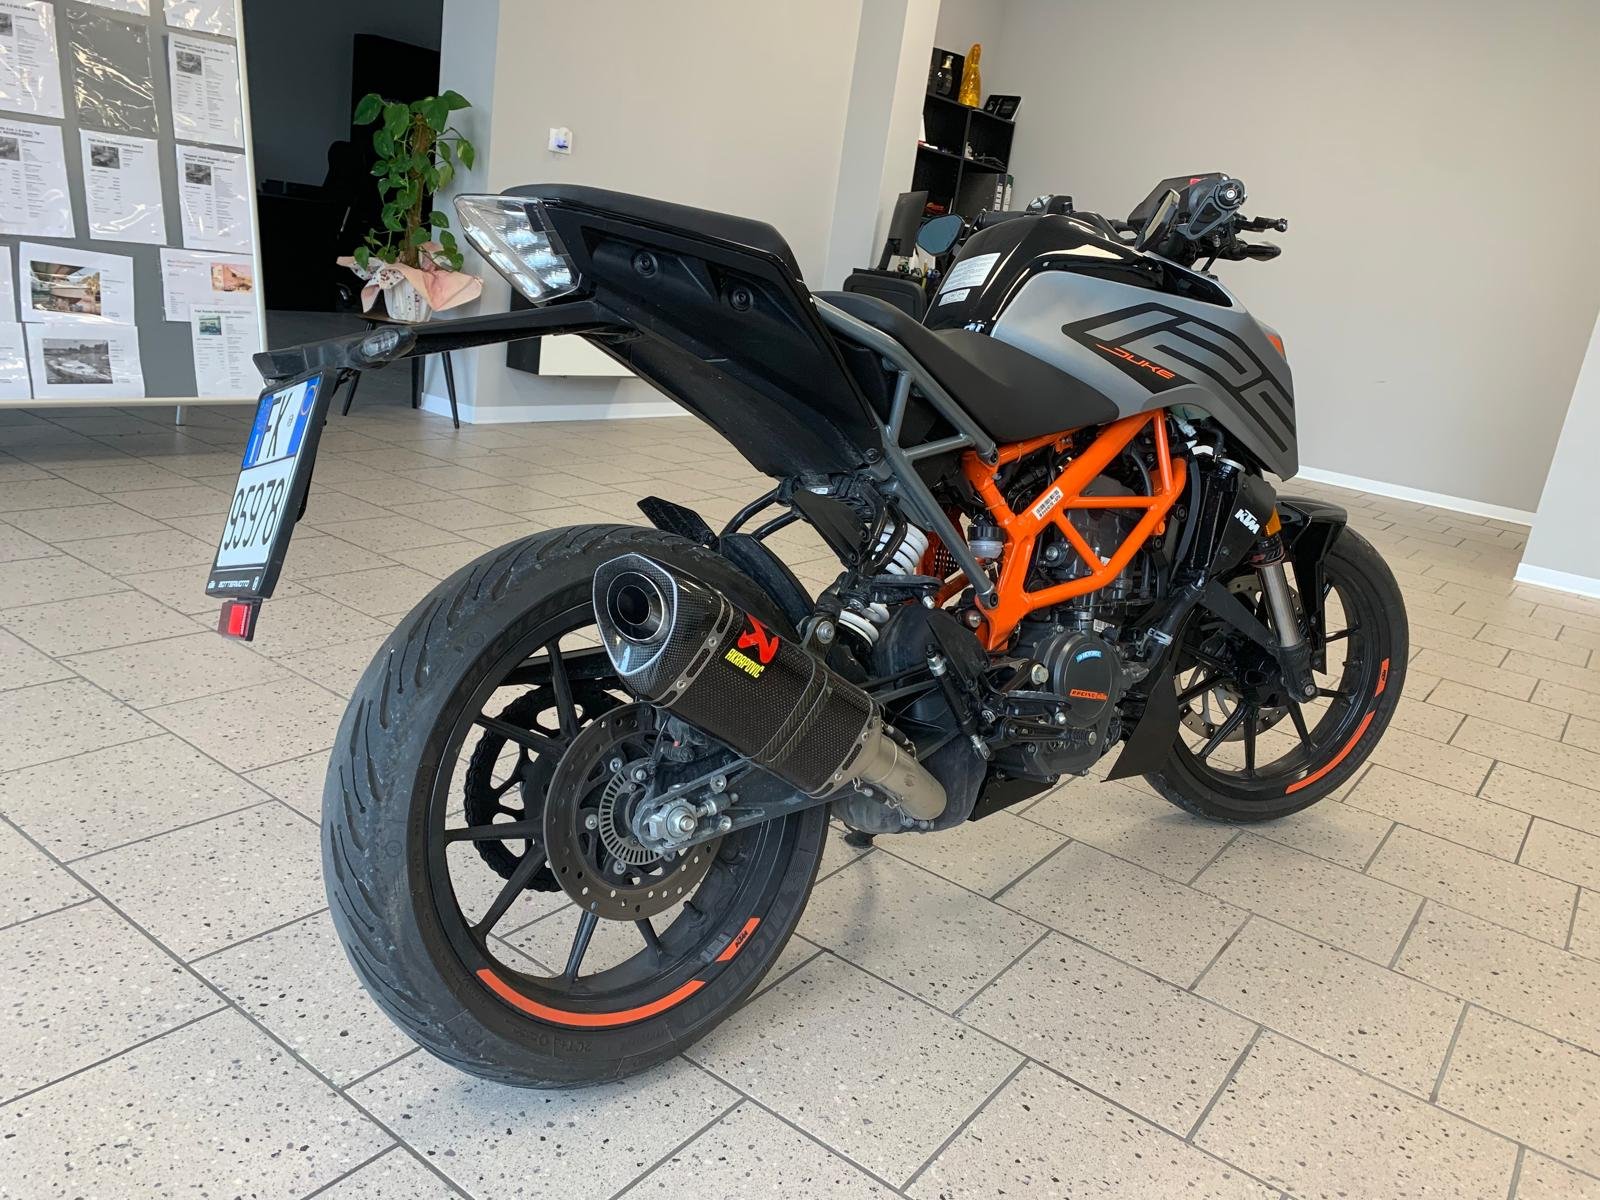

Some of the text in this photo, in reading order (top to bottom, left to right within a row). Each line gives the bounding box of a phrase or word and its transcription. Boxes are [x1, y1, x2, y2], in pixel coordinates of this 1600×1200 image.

[1095, 343, 1176, 380] DUKE
[257, 392, 293, 461] FK
[224, 478, 285, 550] 95978
[1235, 508, 1260, 534] KTM
